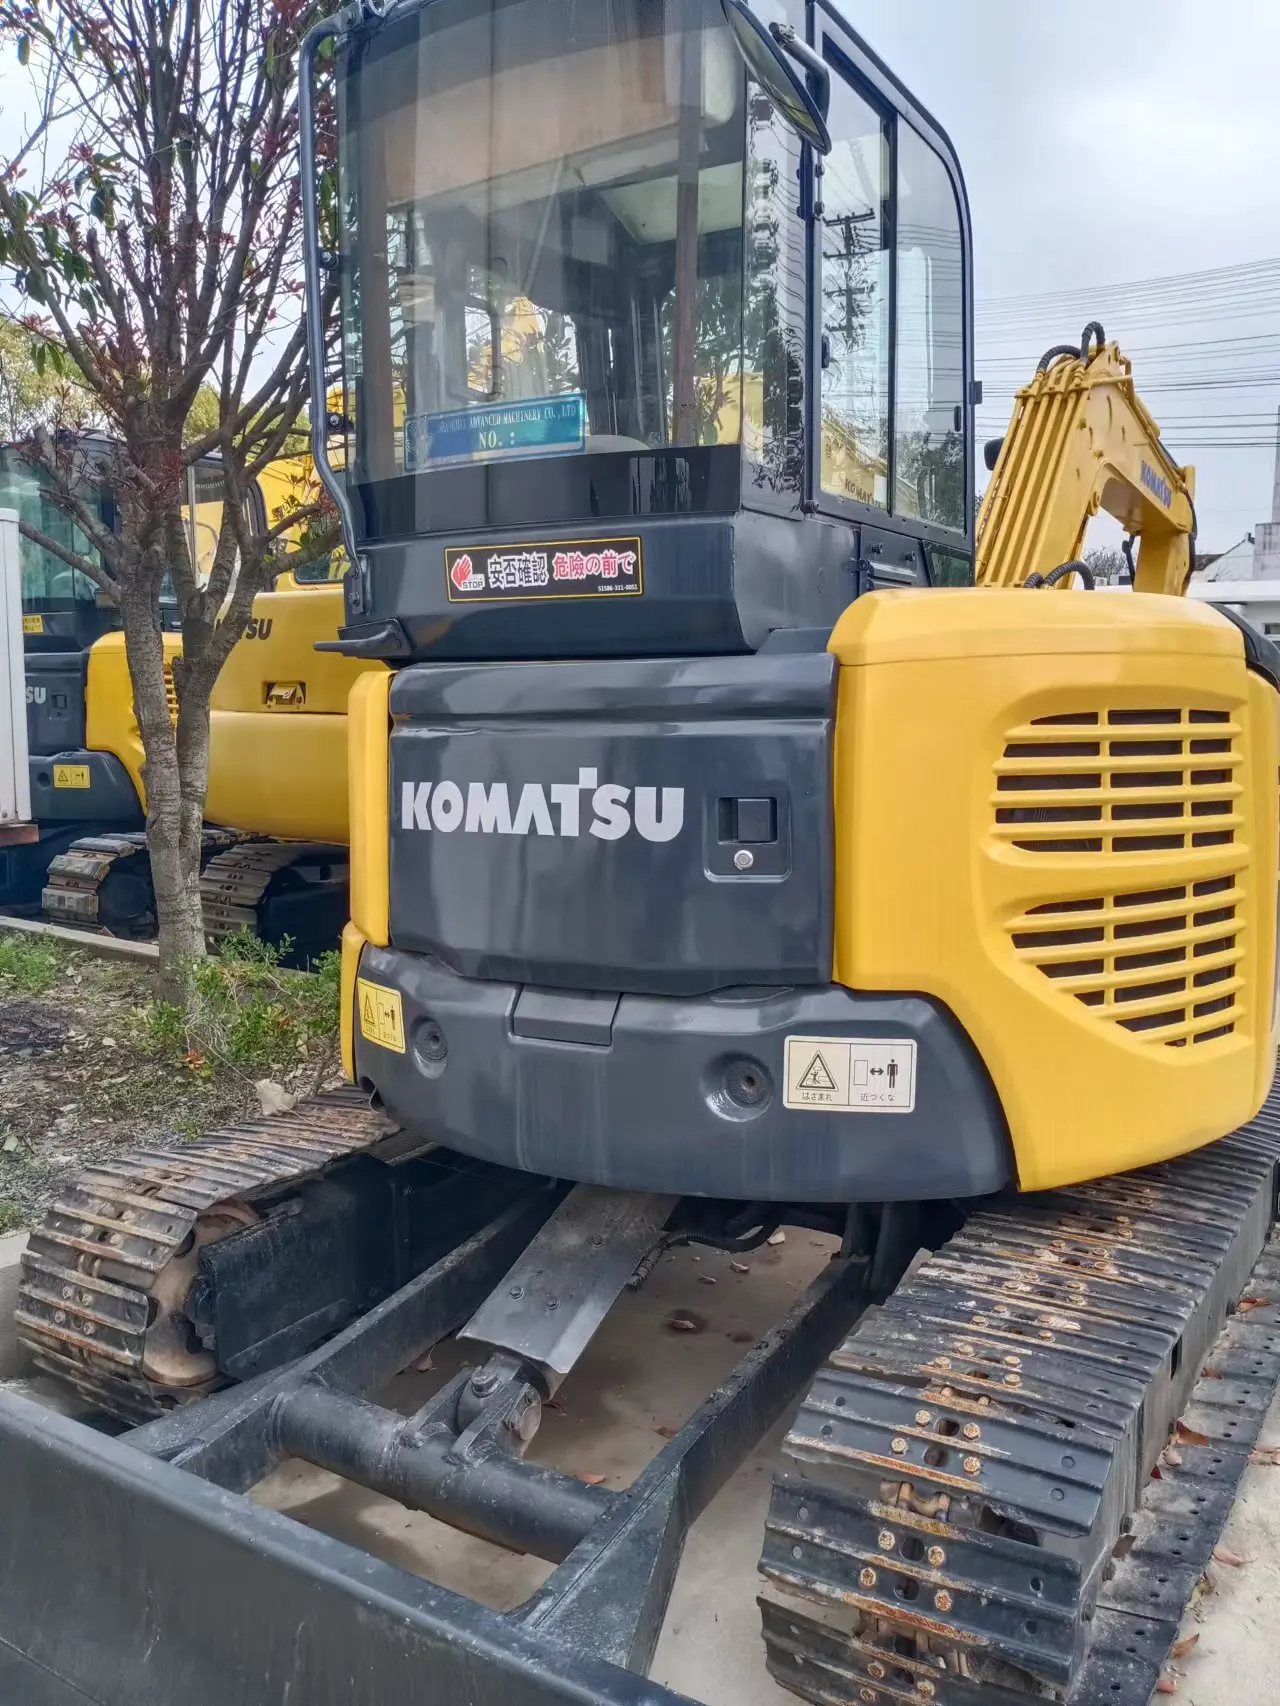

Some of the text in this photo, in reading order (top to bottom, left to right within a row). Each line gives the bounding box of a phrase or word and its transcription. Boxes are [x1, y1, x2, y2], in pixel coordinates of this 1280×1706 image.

[470, 413, 500, 428] ADVANCED
[503, 407, 541, 424] MACHINERY
[487, 551, 549, 590] 安否確認
[462, 581, 483, 589] STOP
[401, 767, 685, 843] KOMATSU
[801, 1091, 833, 1102] はさまれ
[860, 1092, 896, 1102] 近づくな
